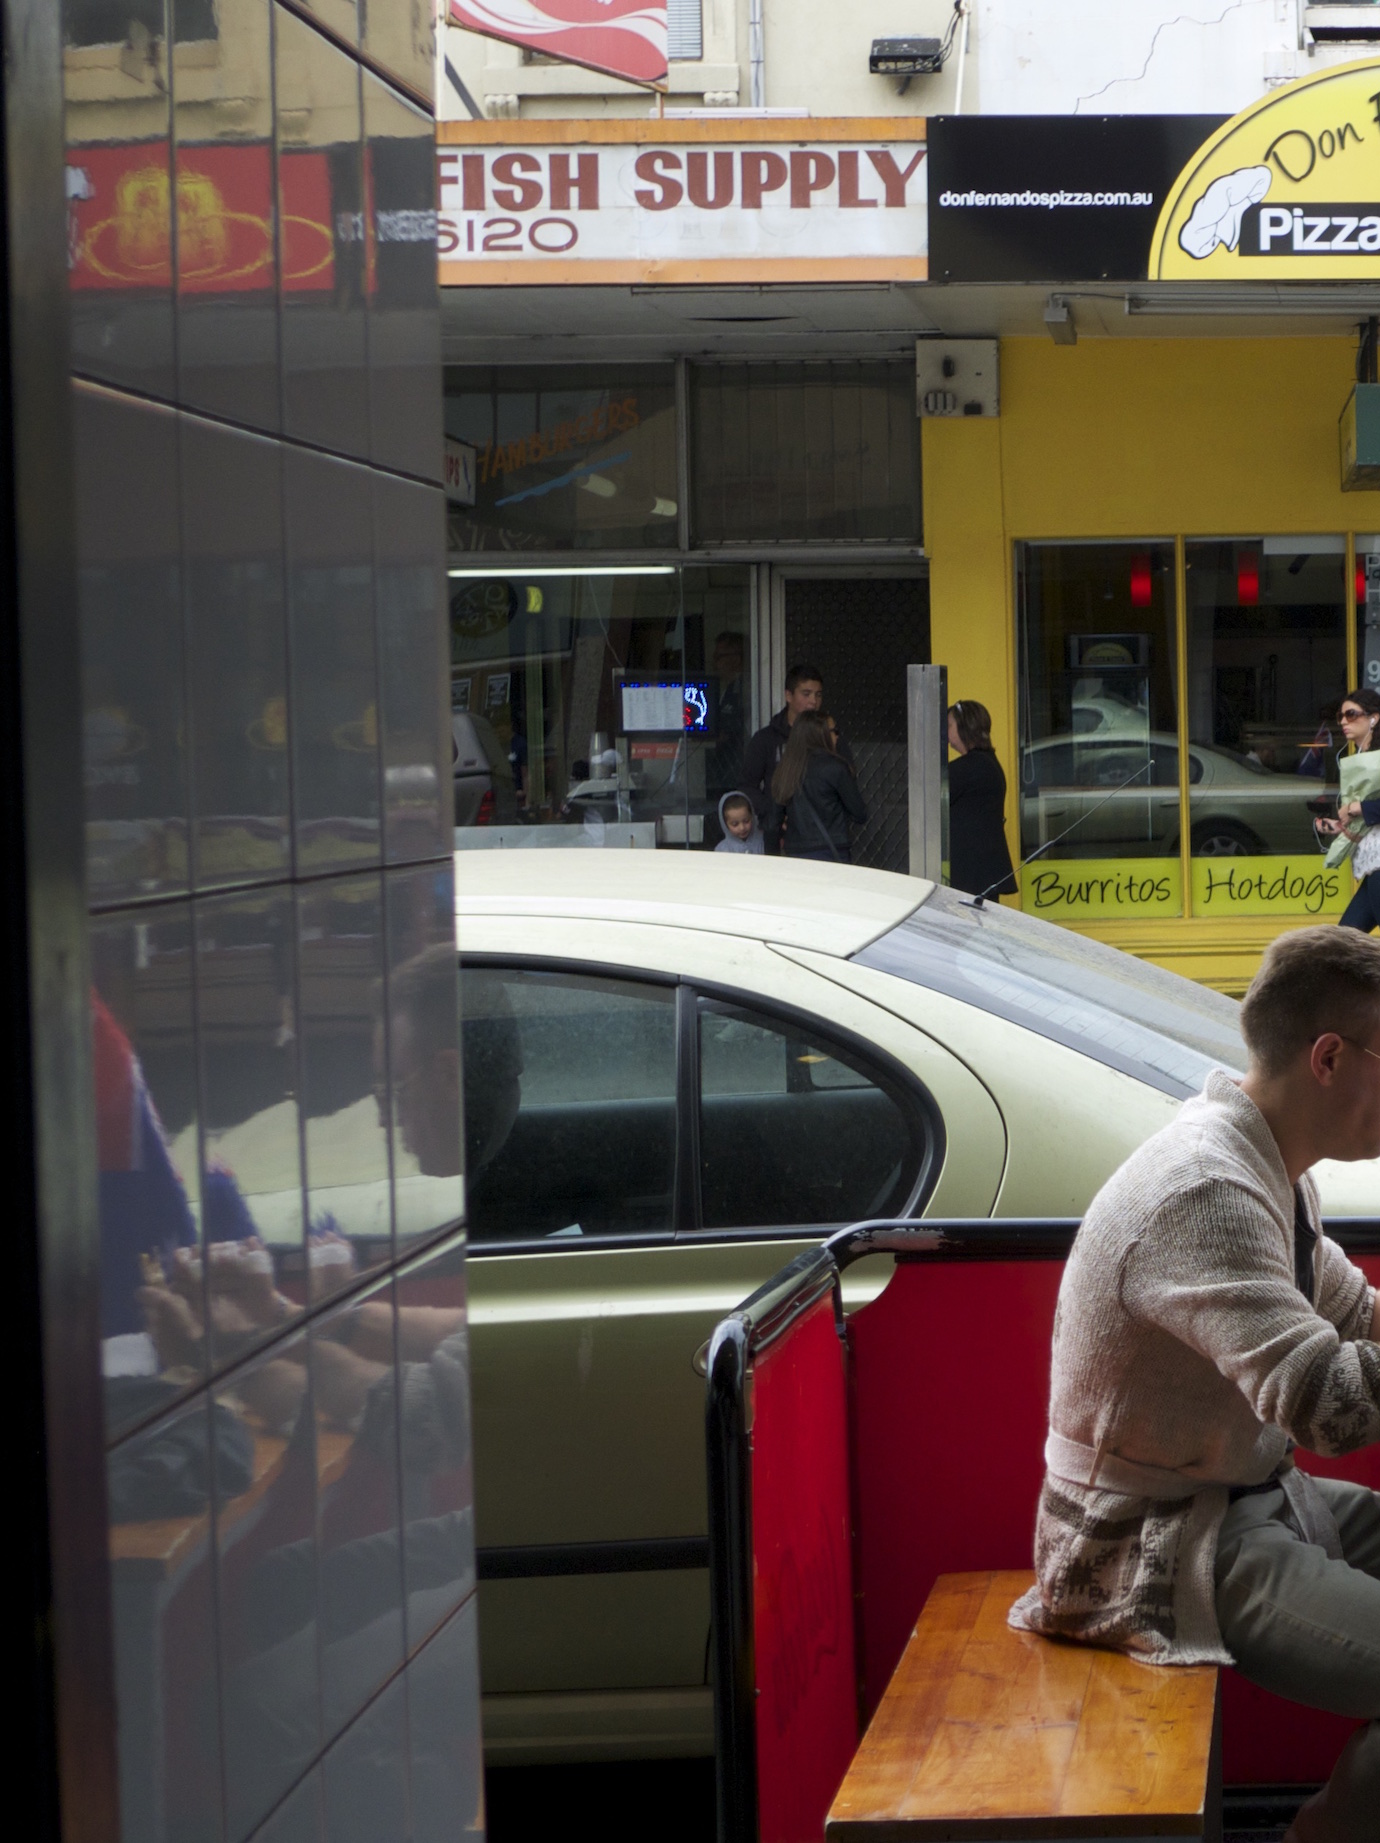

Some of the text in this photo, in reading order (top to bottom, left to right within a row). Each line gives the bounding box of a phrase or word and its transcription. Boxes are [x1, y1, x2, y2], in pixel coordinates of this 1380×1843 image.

[1263, 122, 1365, 183] Don
[437, 150, 927, 212] FISH SUPPLY
[939, 190, 1153, 210] donfernandospizza.com.au
[1031, 871, 1171, 908] Burritos
[1203, 866, 1340, 914] Hotdogs
